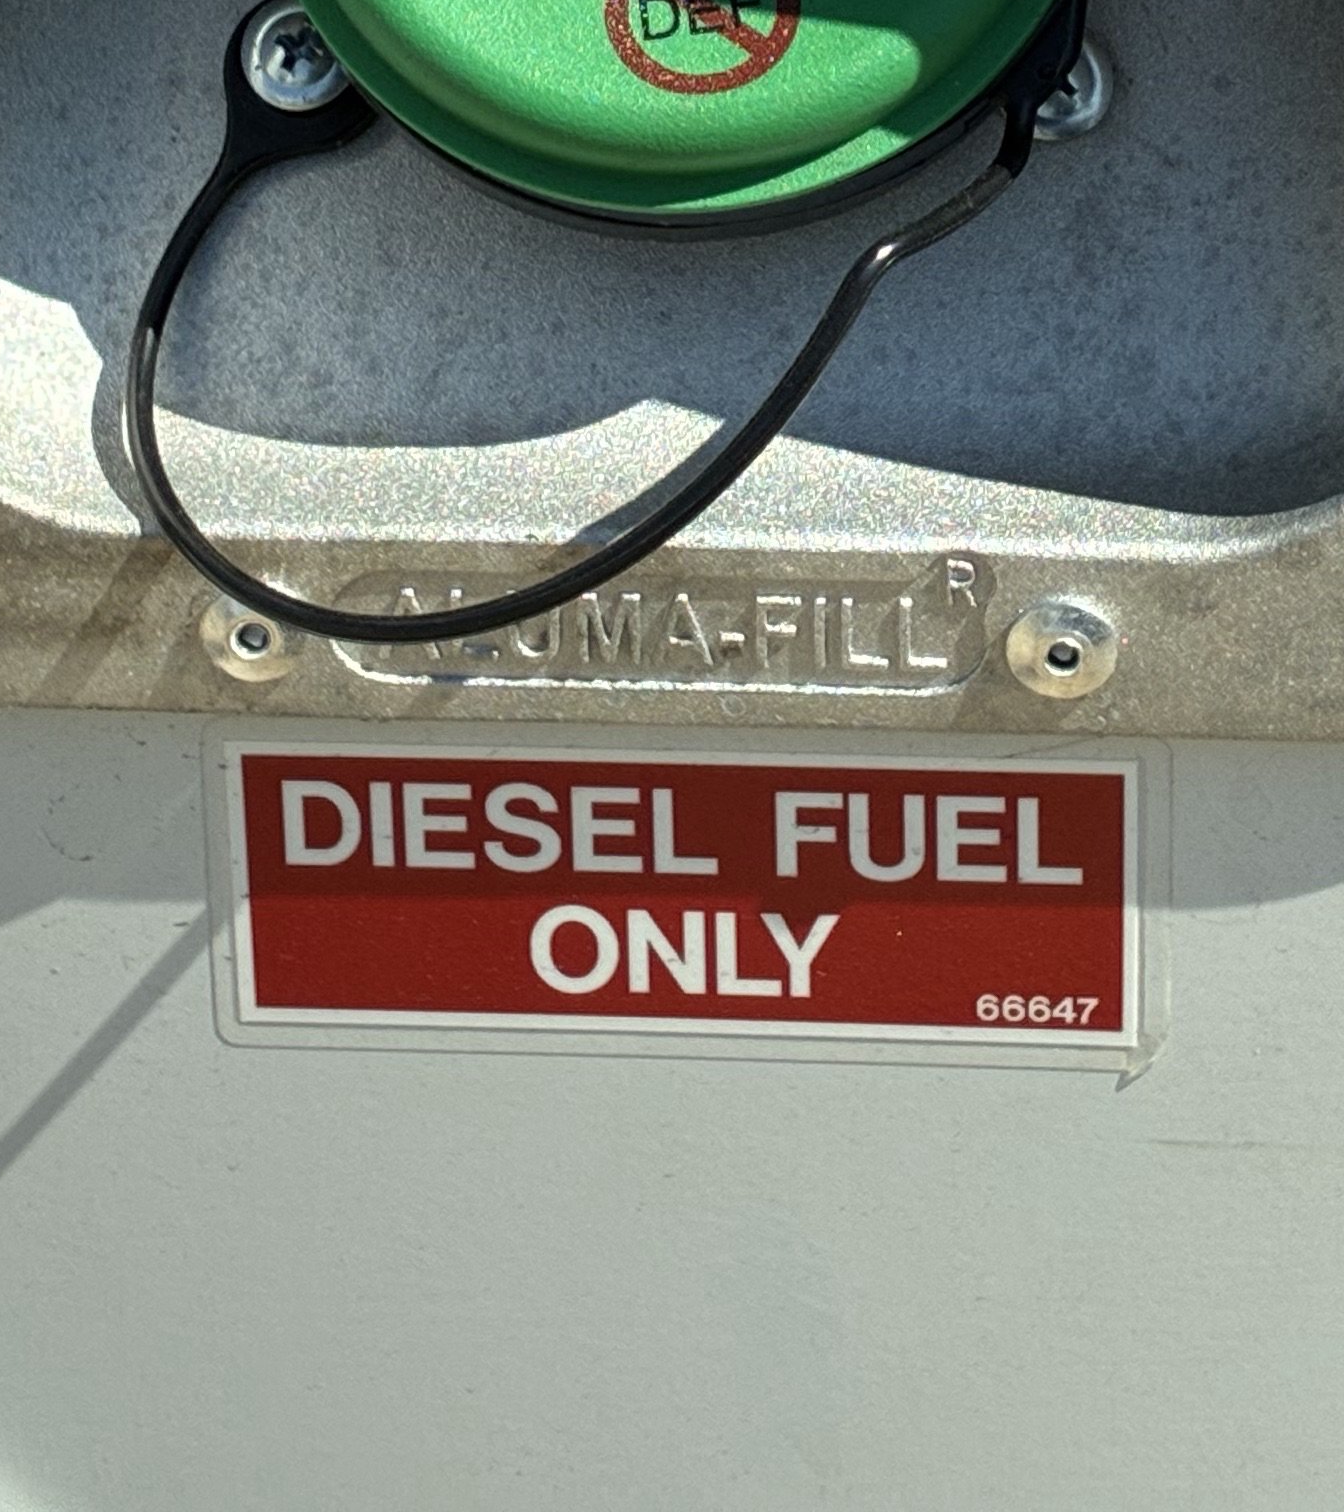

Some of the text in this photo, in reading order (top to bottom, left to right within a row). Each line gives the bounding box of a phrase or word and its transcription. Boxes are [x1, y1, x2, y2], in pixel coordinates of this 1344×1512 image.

[281, 781, 1084, 886] DIESEL FUEL
[529, 904, 839, 998] ONLY
[975, 993, 1100, 1025] 66647
